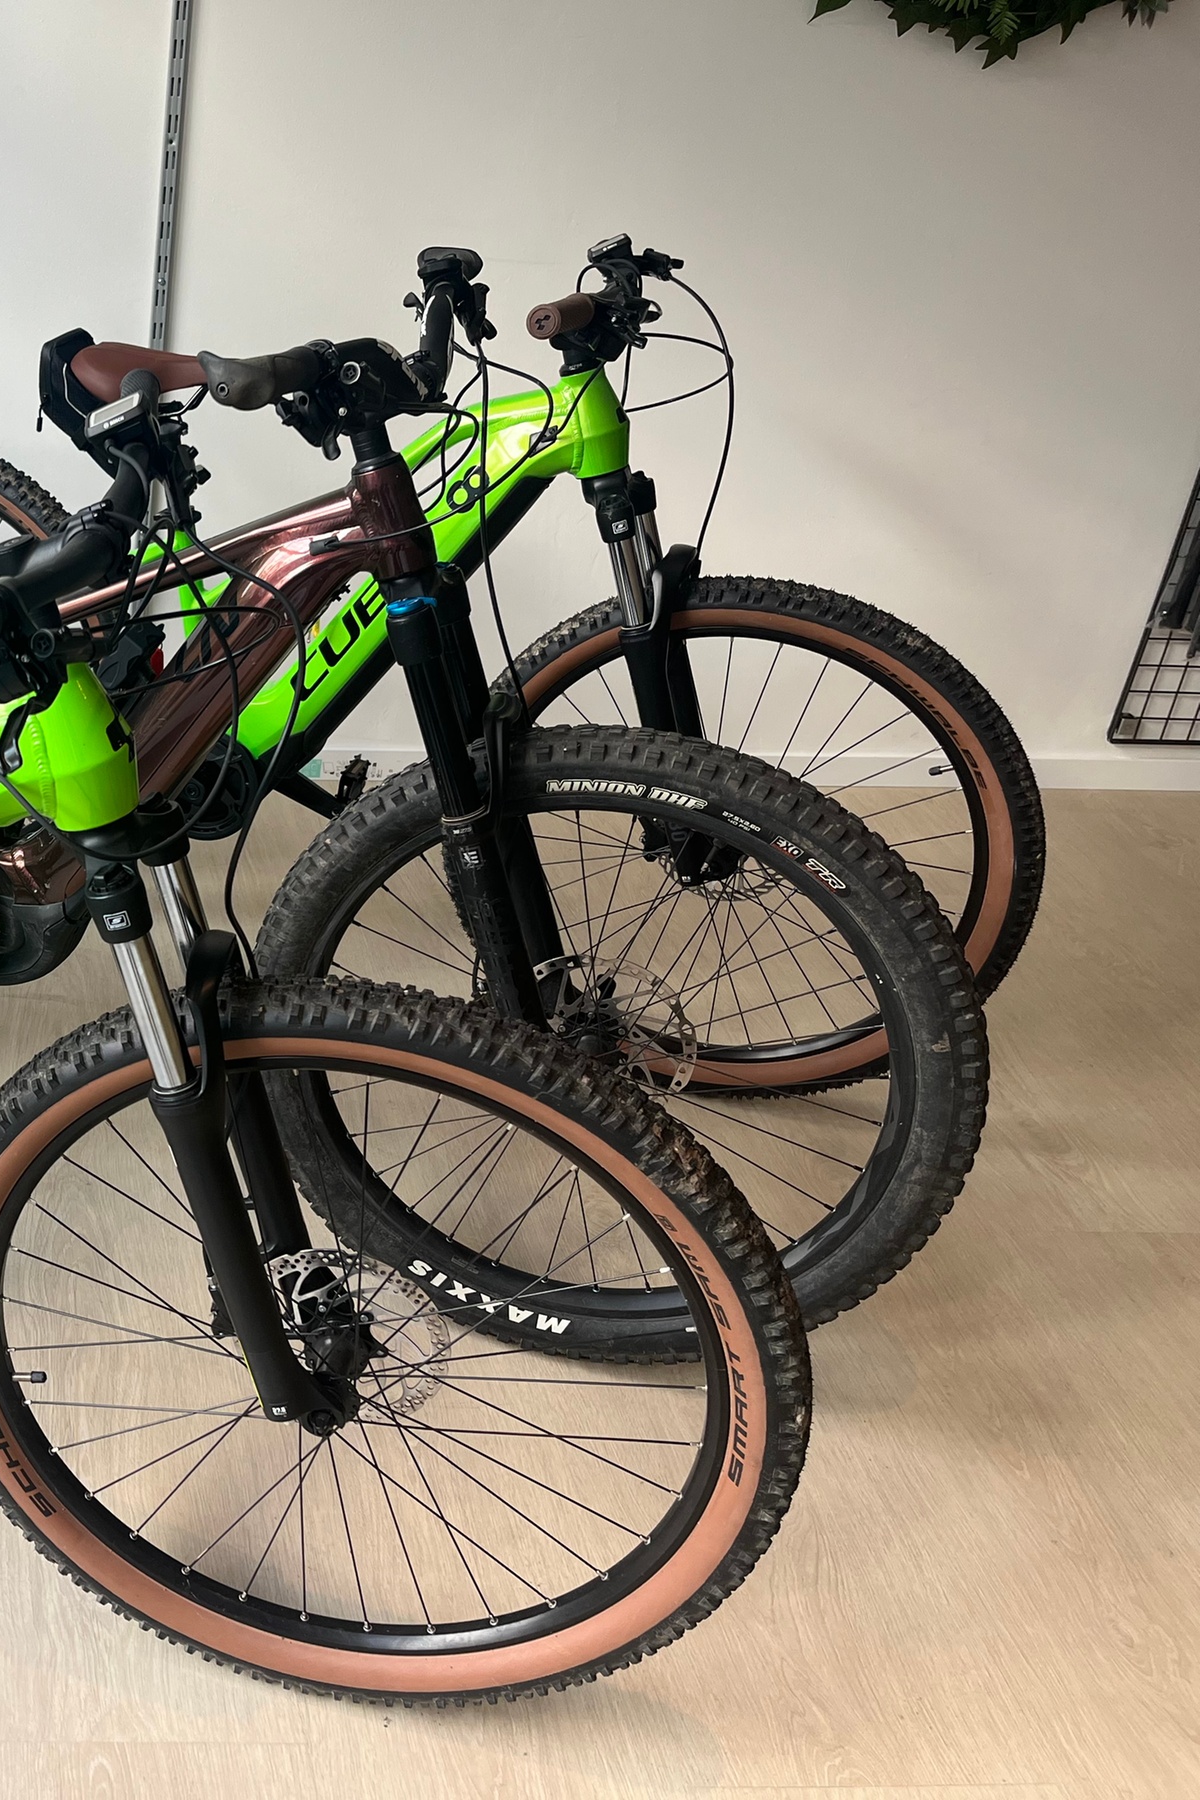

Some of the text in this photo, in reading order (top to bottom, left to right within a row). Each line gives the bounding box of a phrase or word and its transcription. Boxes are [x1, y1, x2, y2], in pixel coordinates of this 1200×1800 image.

[546, 779, 708, 810] MINION DHF
[774, 837, 803, 857] EXO
[407, 1259, 571, 1334] MAXXIS
[677, 1241, 750, 1487] SMART SAM
